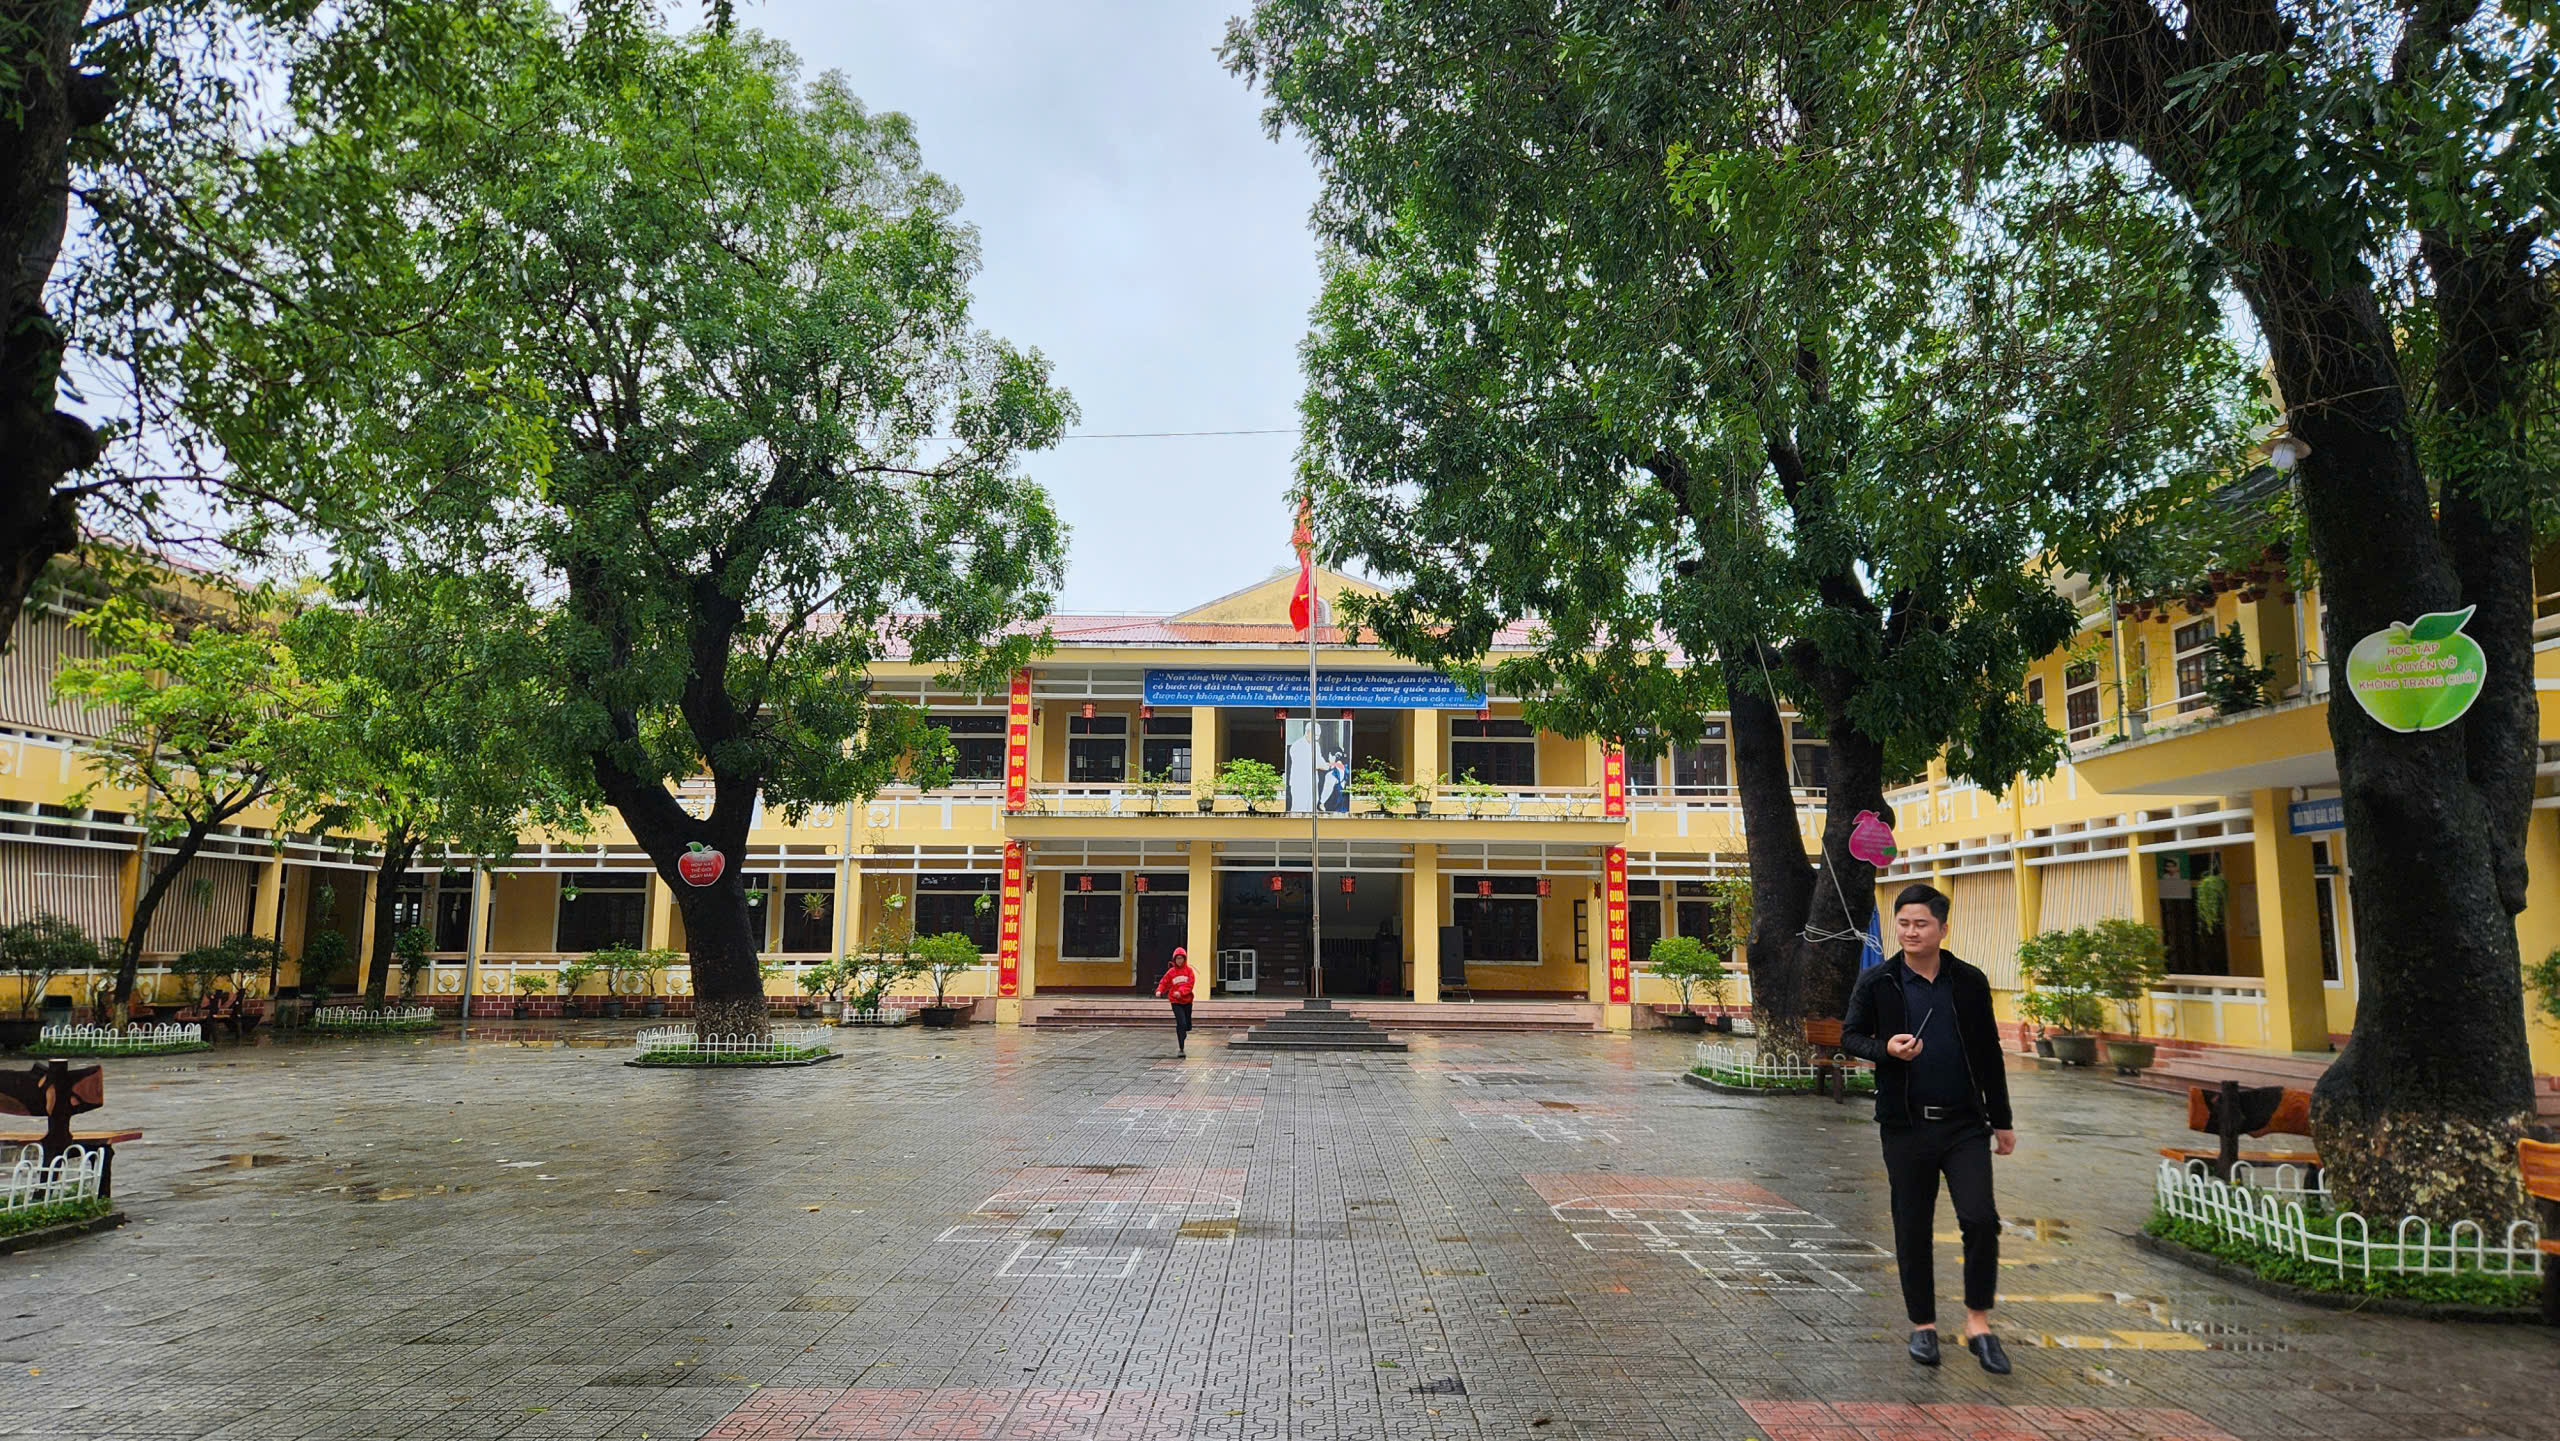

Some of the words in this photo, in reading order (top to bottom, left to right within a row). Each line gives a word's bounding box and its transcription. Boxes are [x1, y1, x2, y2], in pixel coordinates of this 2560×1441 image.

[1344, 675, 1362, 683] hay
[2359, 677, 2400, 690] KHÔNG
[2402, 675, 2444, 689] TRANG
[1007, 869, 1020, 880] THI
[1610, 871, 1623, 883] THI
[1004, 918, 1018, 933] TỐT
[1611, 925, 1625, 941] TỐT
[1003, 940, 1018, 954] HỌC
[1003, 954, 1016, 969] TỐT
[1610, 948, 1626, 962] HỌC
[1612, 963, 1626, 980] TỐT
